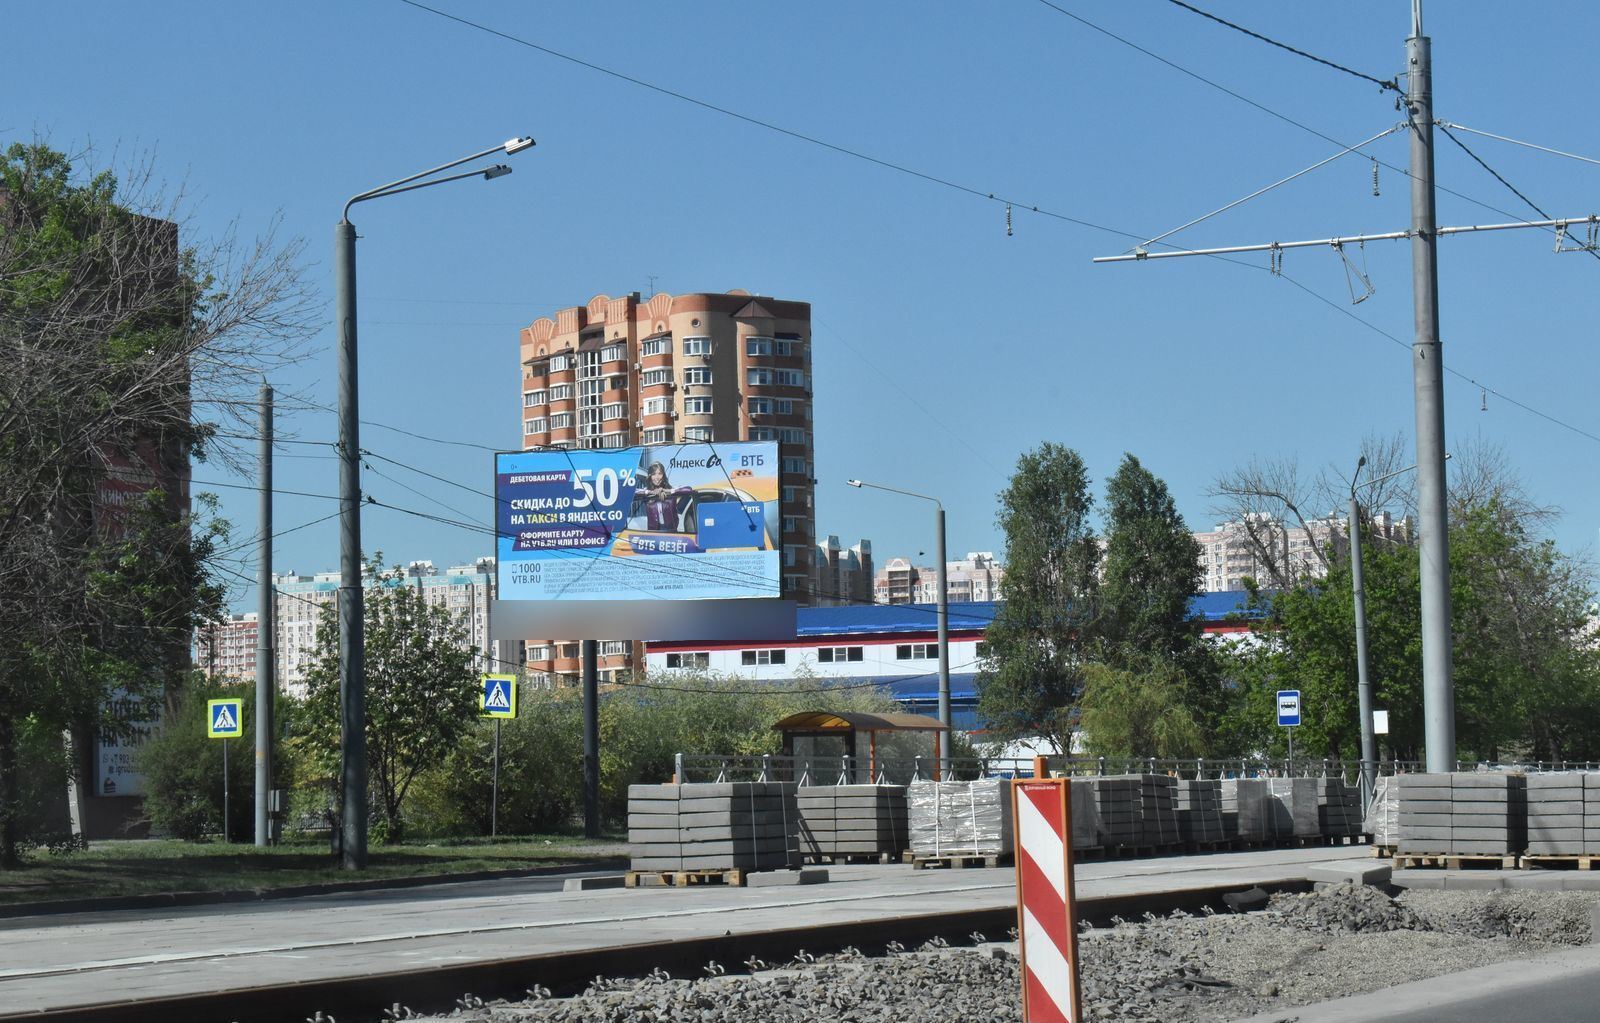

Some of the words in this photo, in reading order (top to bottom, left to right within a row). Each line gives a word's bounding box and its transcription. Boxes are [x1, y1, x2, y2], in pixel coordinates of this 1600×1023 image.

[669, 457, 705, 469] Яндекс
[741, 454, 764, 467] ВТБ
[510, 475, 545, 484] ДЕБЕТОВАЯ
[546, 474, 567, 482] КАРТА
[511, 498, 553, 511] СКИДКА
[555, 497, 570, 510] ДО
[747, 505, 761, 514] ВТБ
[511, 514, 525, 525] НА
[527, 513, 558, 524] ТАКСИ
[559, 513, 566, 522] В
[567, 511, 607, 524] ЯНДЕКС
[608, 510, 623, 521] GO
[520, 530, 560, 539] ОФОРМИТЕ
[561, 529, 585, 538] КАРТУ
[557, 538, 573, 546] ИЛИ
[573, 538, 579, 546] В
[580, 537, 605, 546] ОФИСЕ
[638, 539, 656, 551] ВТБ
[658, 540, 688, 553] ВЕЗЁТ
[518, 563, 541, 573] 1000
[511, 574, 541, 584] VTB.RU
